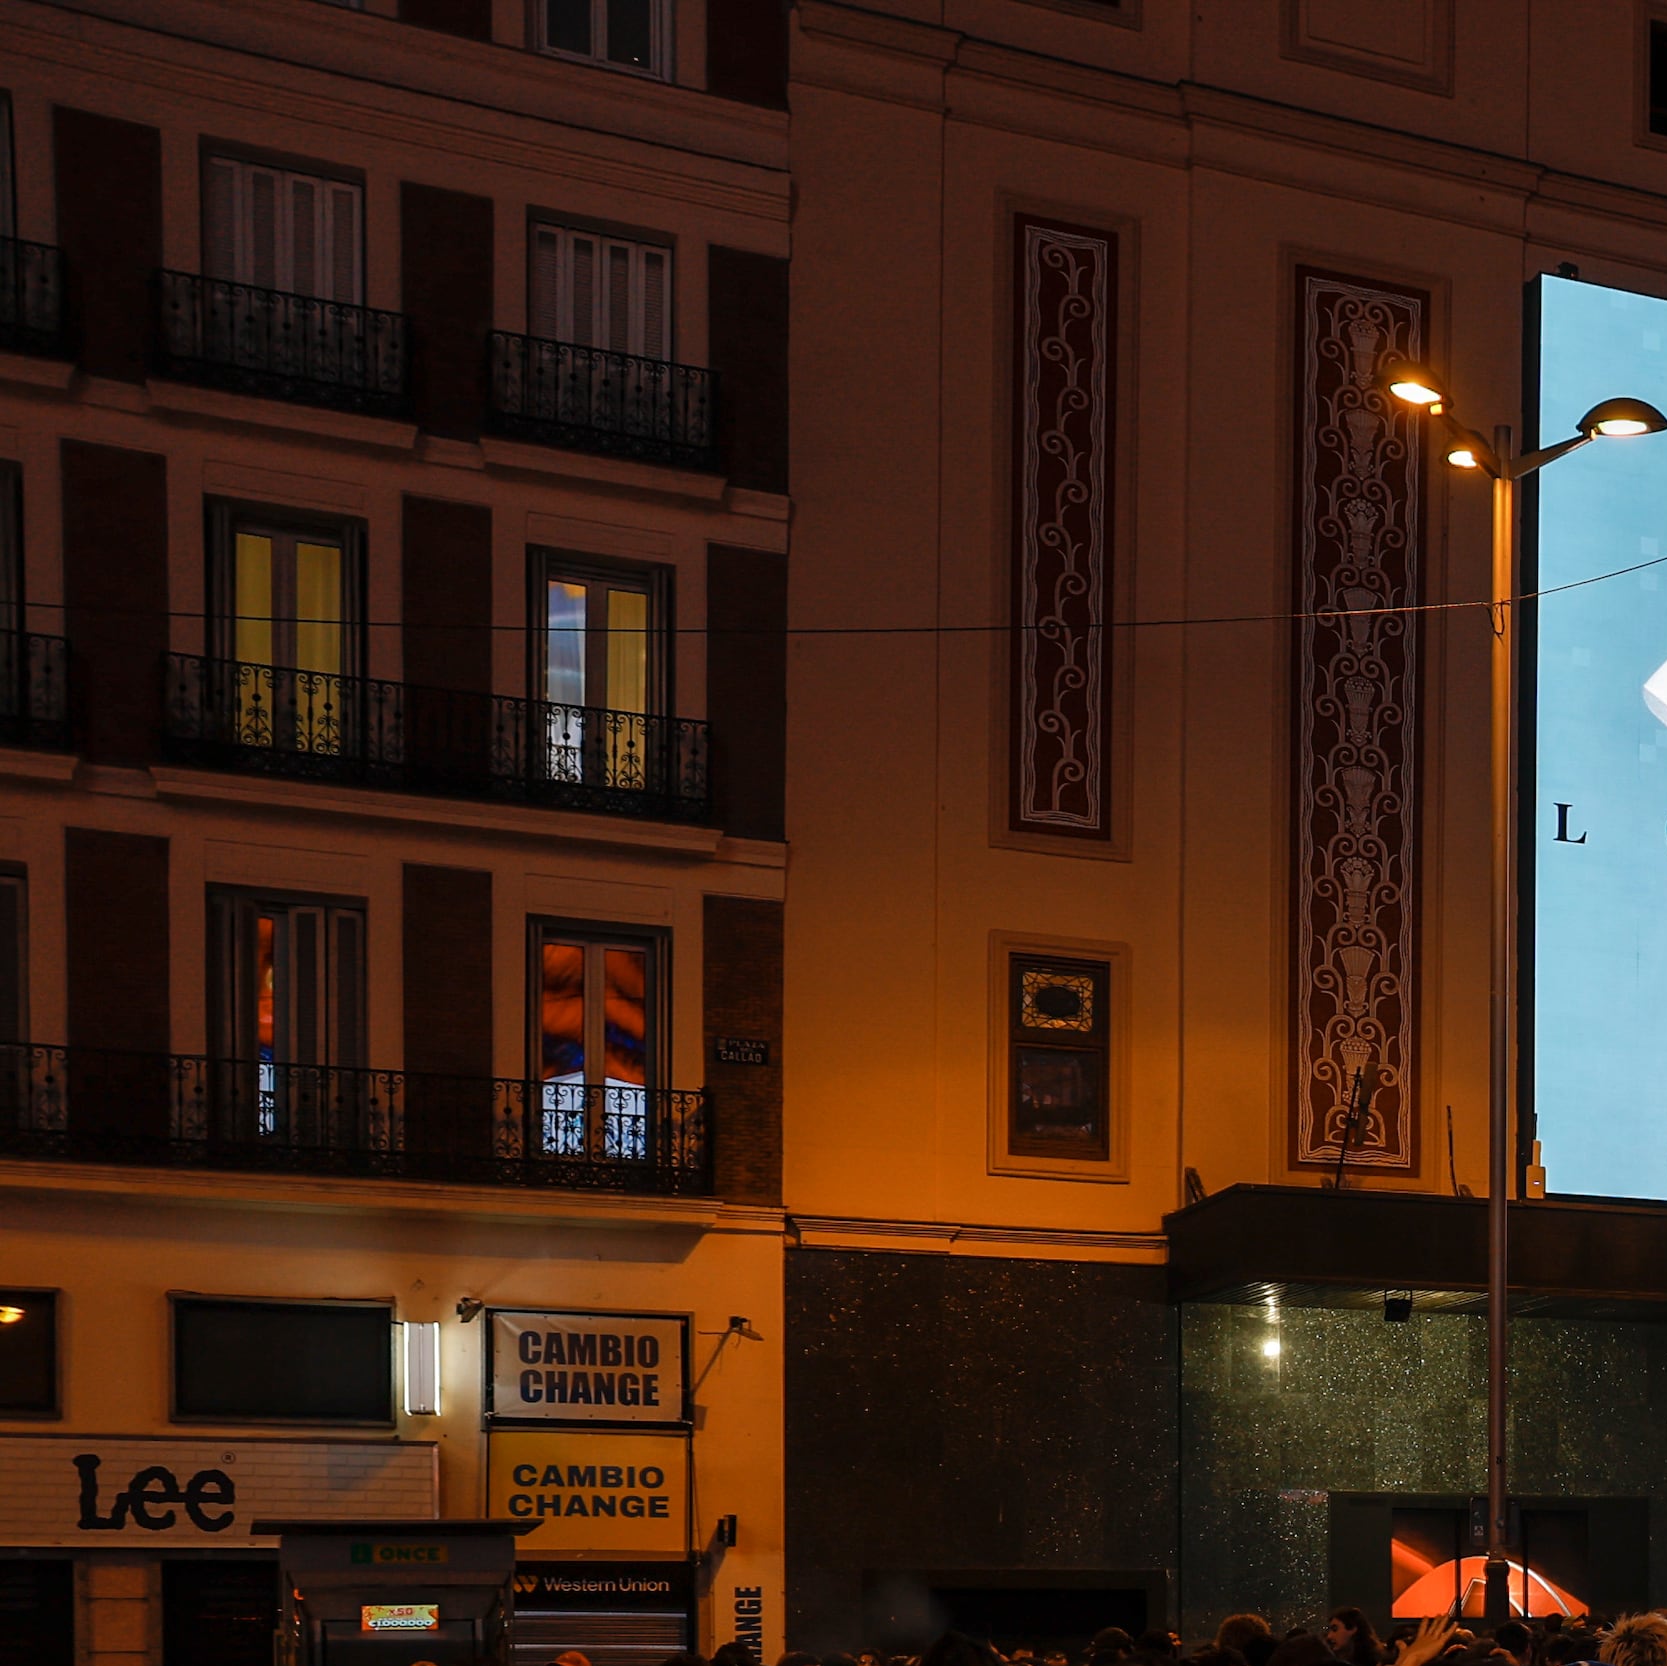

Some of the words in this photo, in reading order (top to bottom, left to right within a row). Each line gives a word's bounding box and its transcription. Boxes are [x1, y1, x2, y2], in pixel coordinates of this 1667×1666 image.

[1553, 802, 1587, 844] L
[720, 1050, 763, 1064] CALLAO
[518, 1331, 660, 1369] CAMBIO
[519, 1369, 660, 1407] CHANGE
[512, 1464, 664, 1489] CAMBIO
[73, 1454, 235, 1532] Lee
[508, 1494, 670, 1518] CHANGE
[379, 1547, 441, 1561] ONCE
[543, 1576, 617, 1592] Western
[618, 1577, 671, 1592] Union
